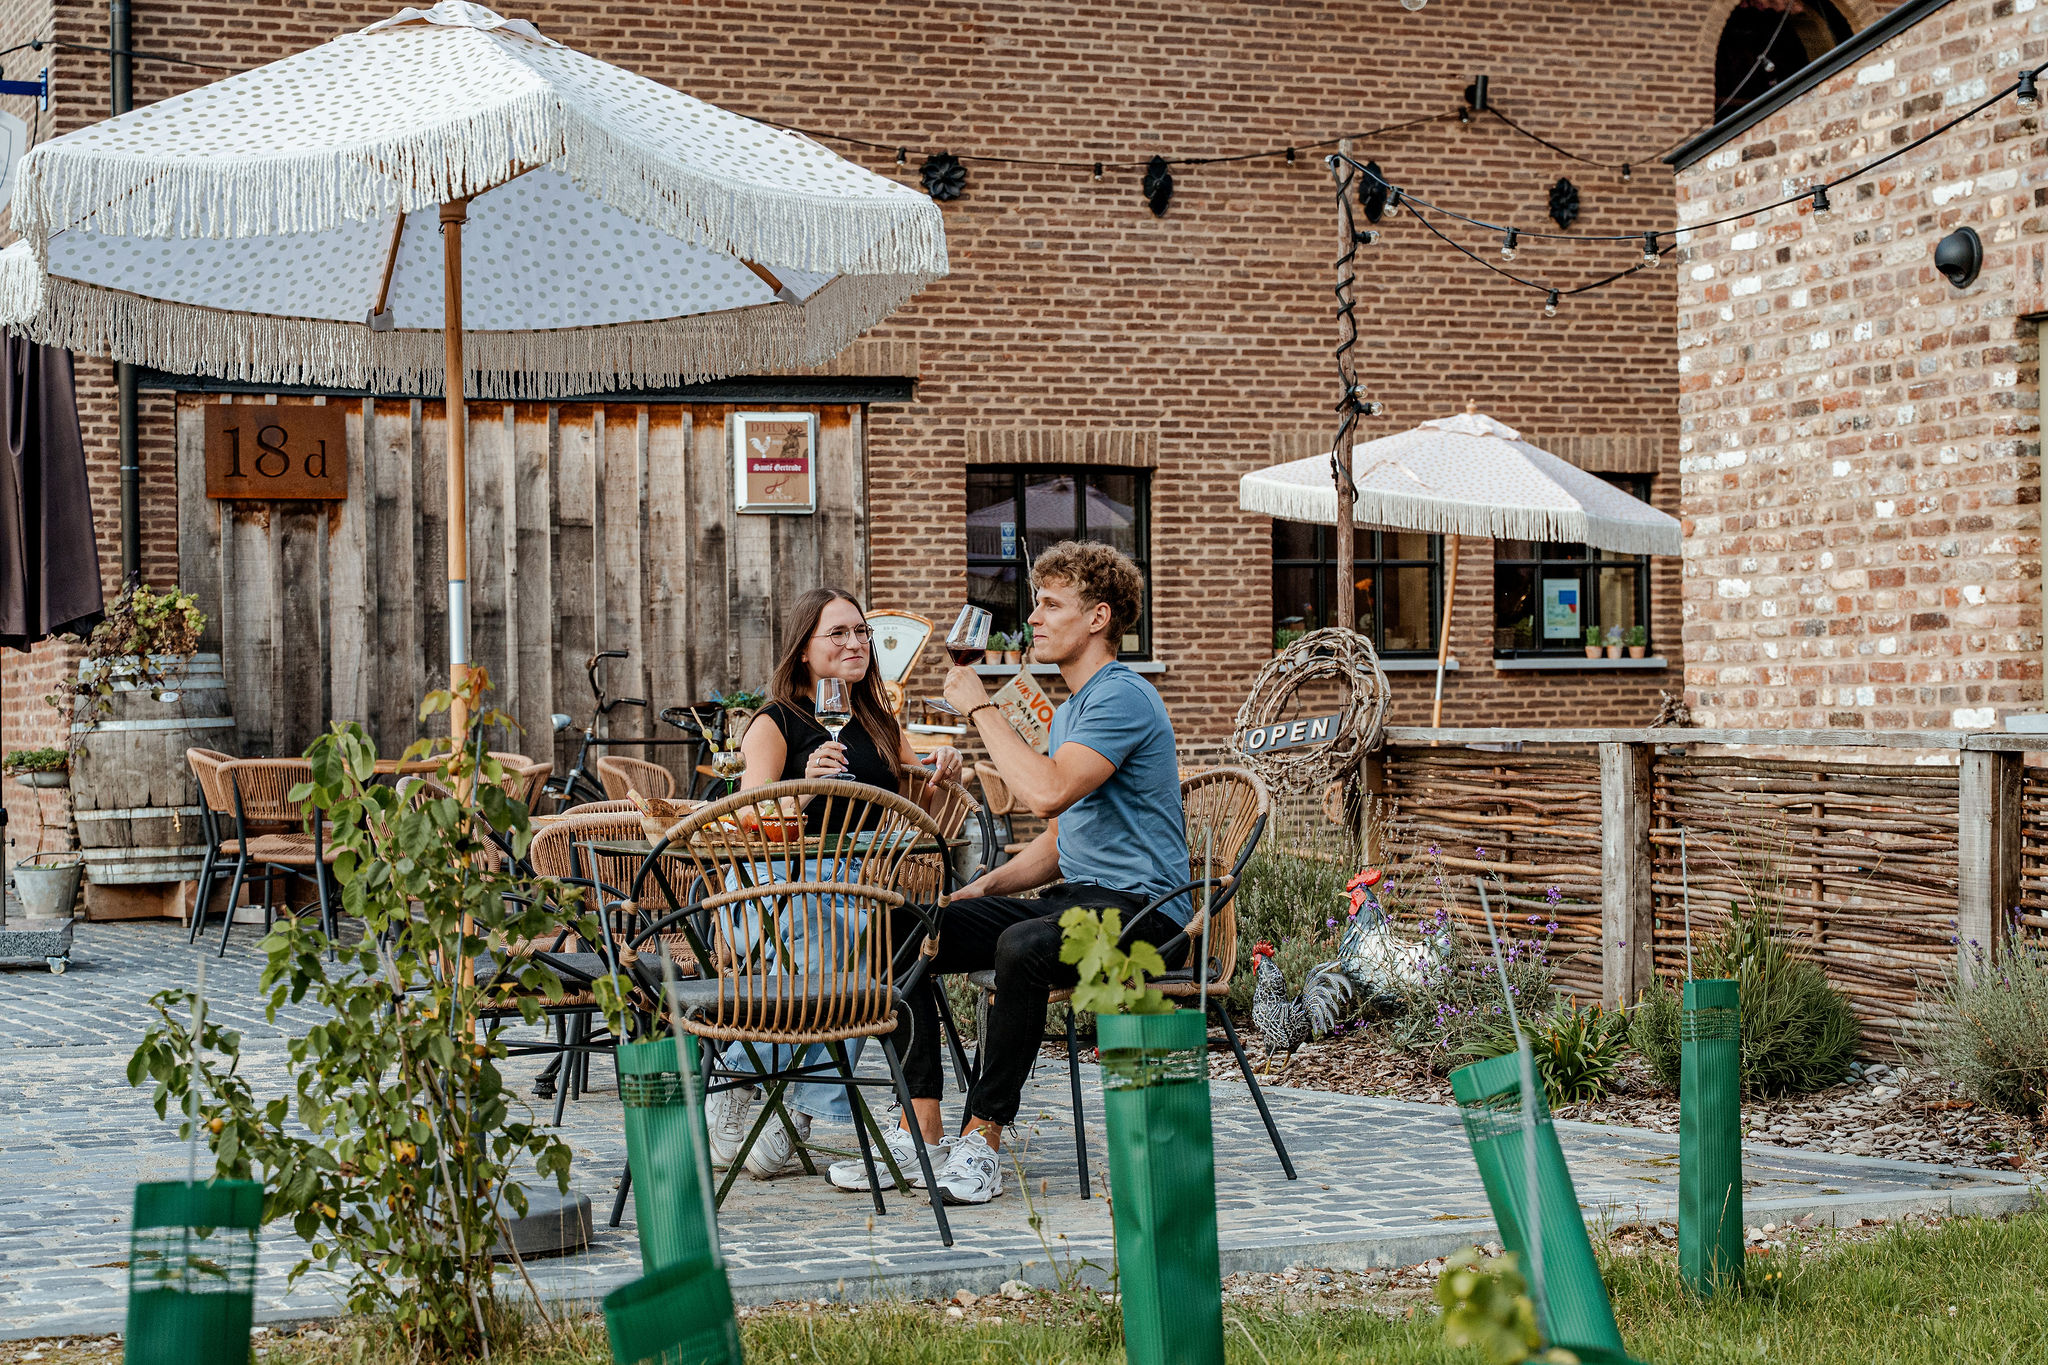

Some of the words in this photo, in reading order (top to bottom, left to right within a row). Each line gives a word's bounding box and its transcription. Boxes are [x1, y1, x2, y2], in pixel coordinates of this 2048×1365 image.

[223, 425, 290, 478] 18
[304, 439, 328, 478] d
[1014, 677, 1033, 700] VINS
[1029, 692, 1054, 734] VO
[1249, 718, 1330, 749] OPEN
